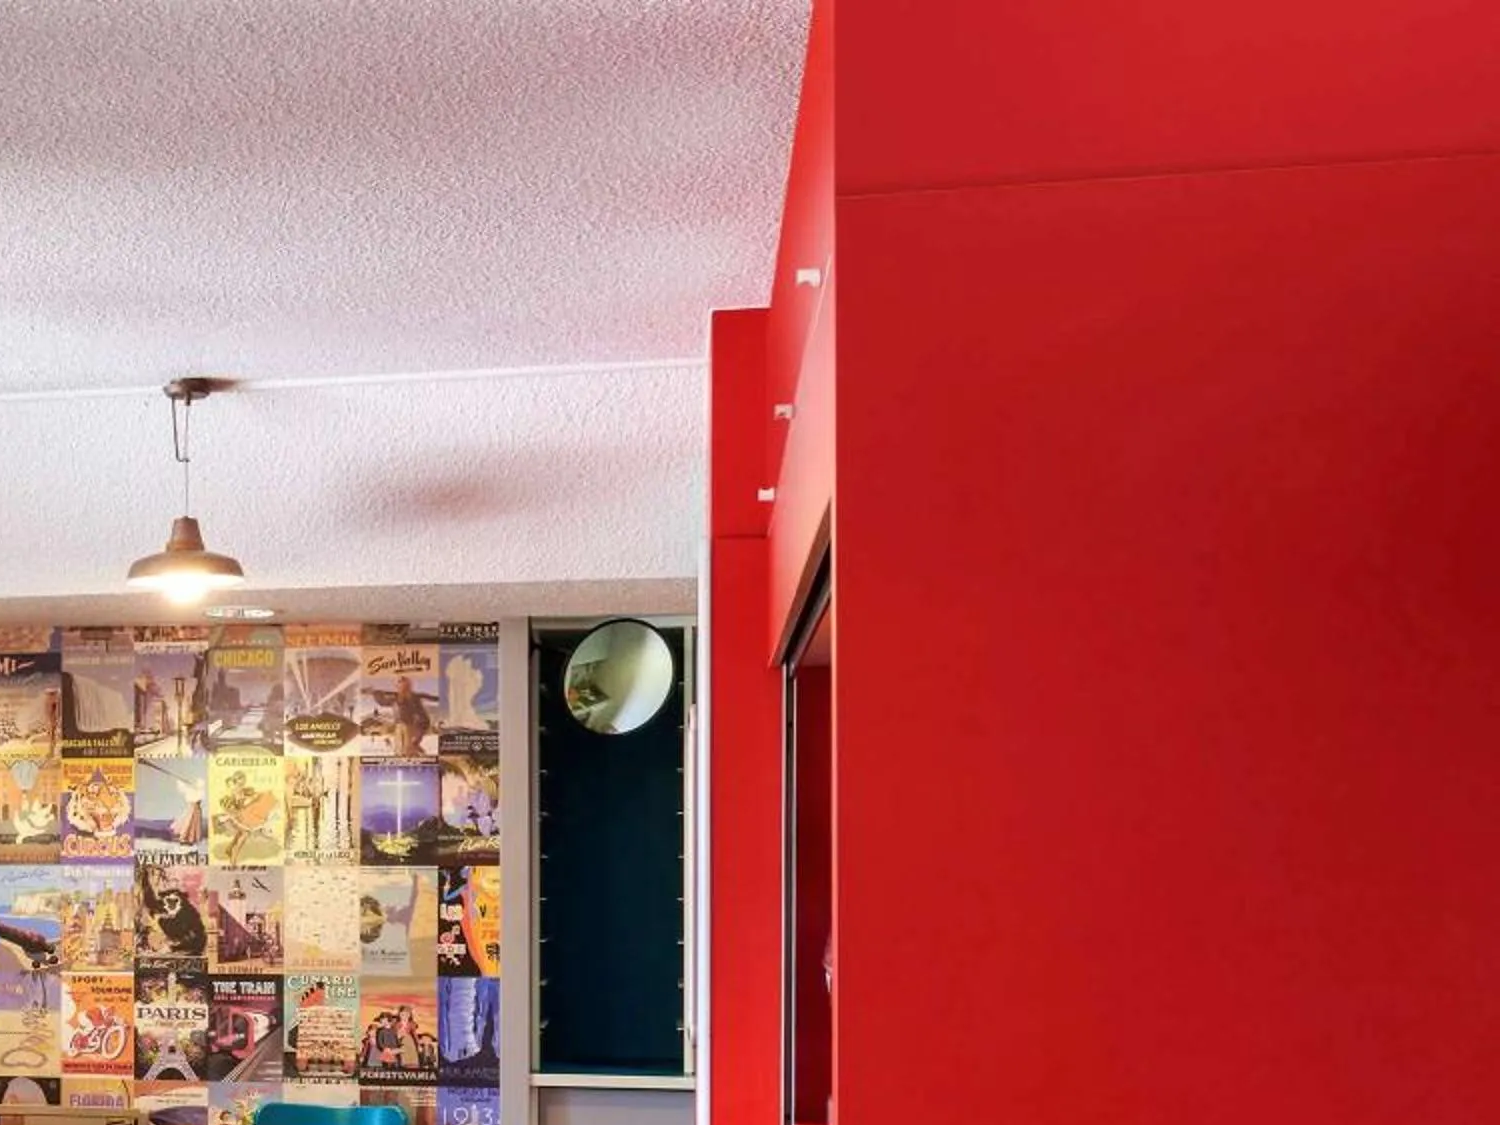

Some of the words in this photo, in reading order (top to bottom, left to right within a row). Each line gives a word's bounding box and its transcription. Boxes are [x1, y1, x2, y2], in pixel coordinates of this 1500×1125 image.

[214, 650, 275, 667] CHICAGO
[367, 655, 398, 676] Sun
[397, 649, 431, 671] Valley
[216, 757, 278, 767] CARIBBEAN
[63, 833, 134, 858] CIRCUS
[212, 981, 236, 995] THE
[240, 981, 276, 995] TRAIN
[287, 974, 353, 991] CUNARD
[136, 1007, 207, 1020] PARIS
[69, 1093, 125, 1108] FLORIDA
